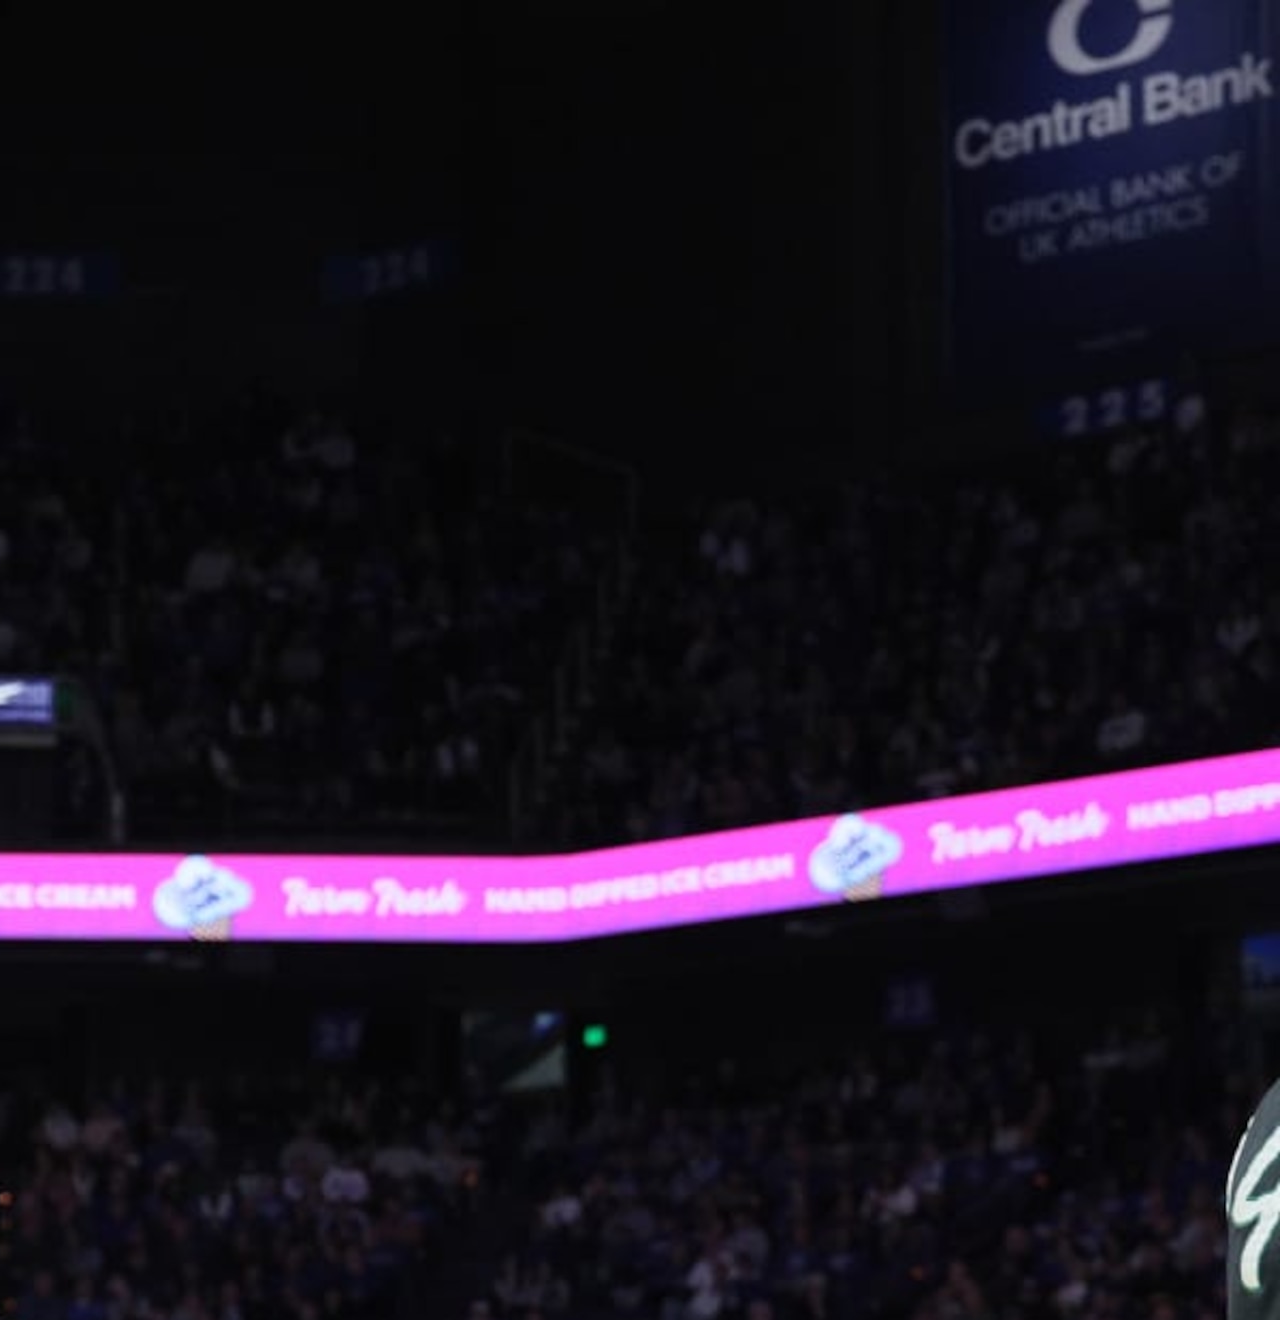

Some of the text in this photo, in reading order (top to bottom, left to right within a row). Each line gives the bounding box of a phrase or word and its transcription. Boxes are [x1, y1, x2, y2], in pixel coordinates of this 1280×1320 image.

[955, 52, 1272, 168] Central Bank
[984, 150, 1243, 236] OFFICIAL BANK OF
[1019, 195, 1209, 263] UK ATHLETICS
[1058, 378, 1166, 437] 225
